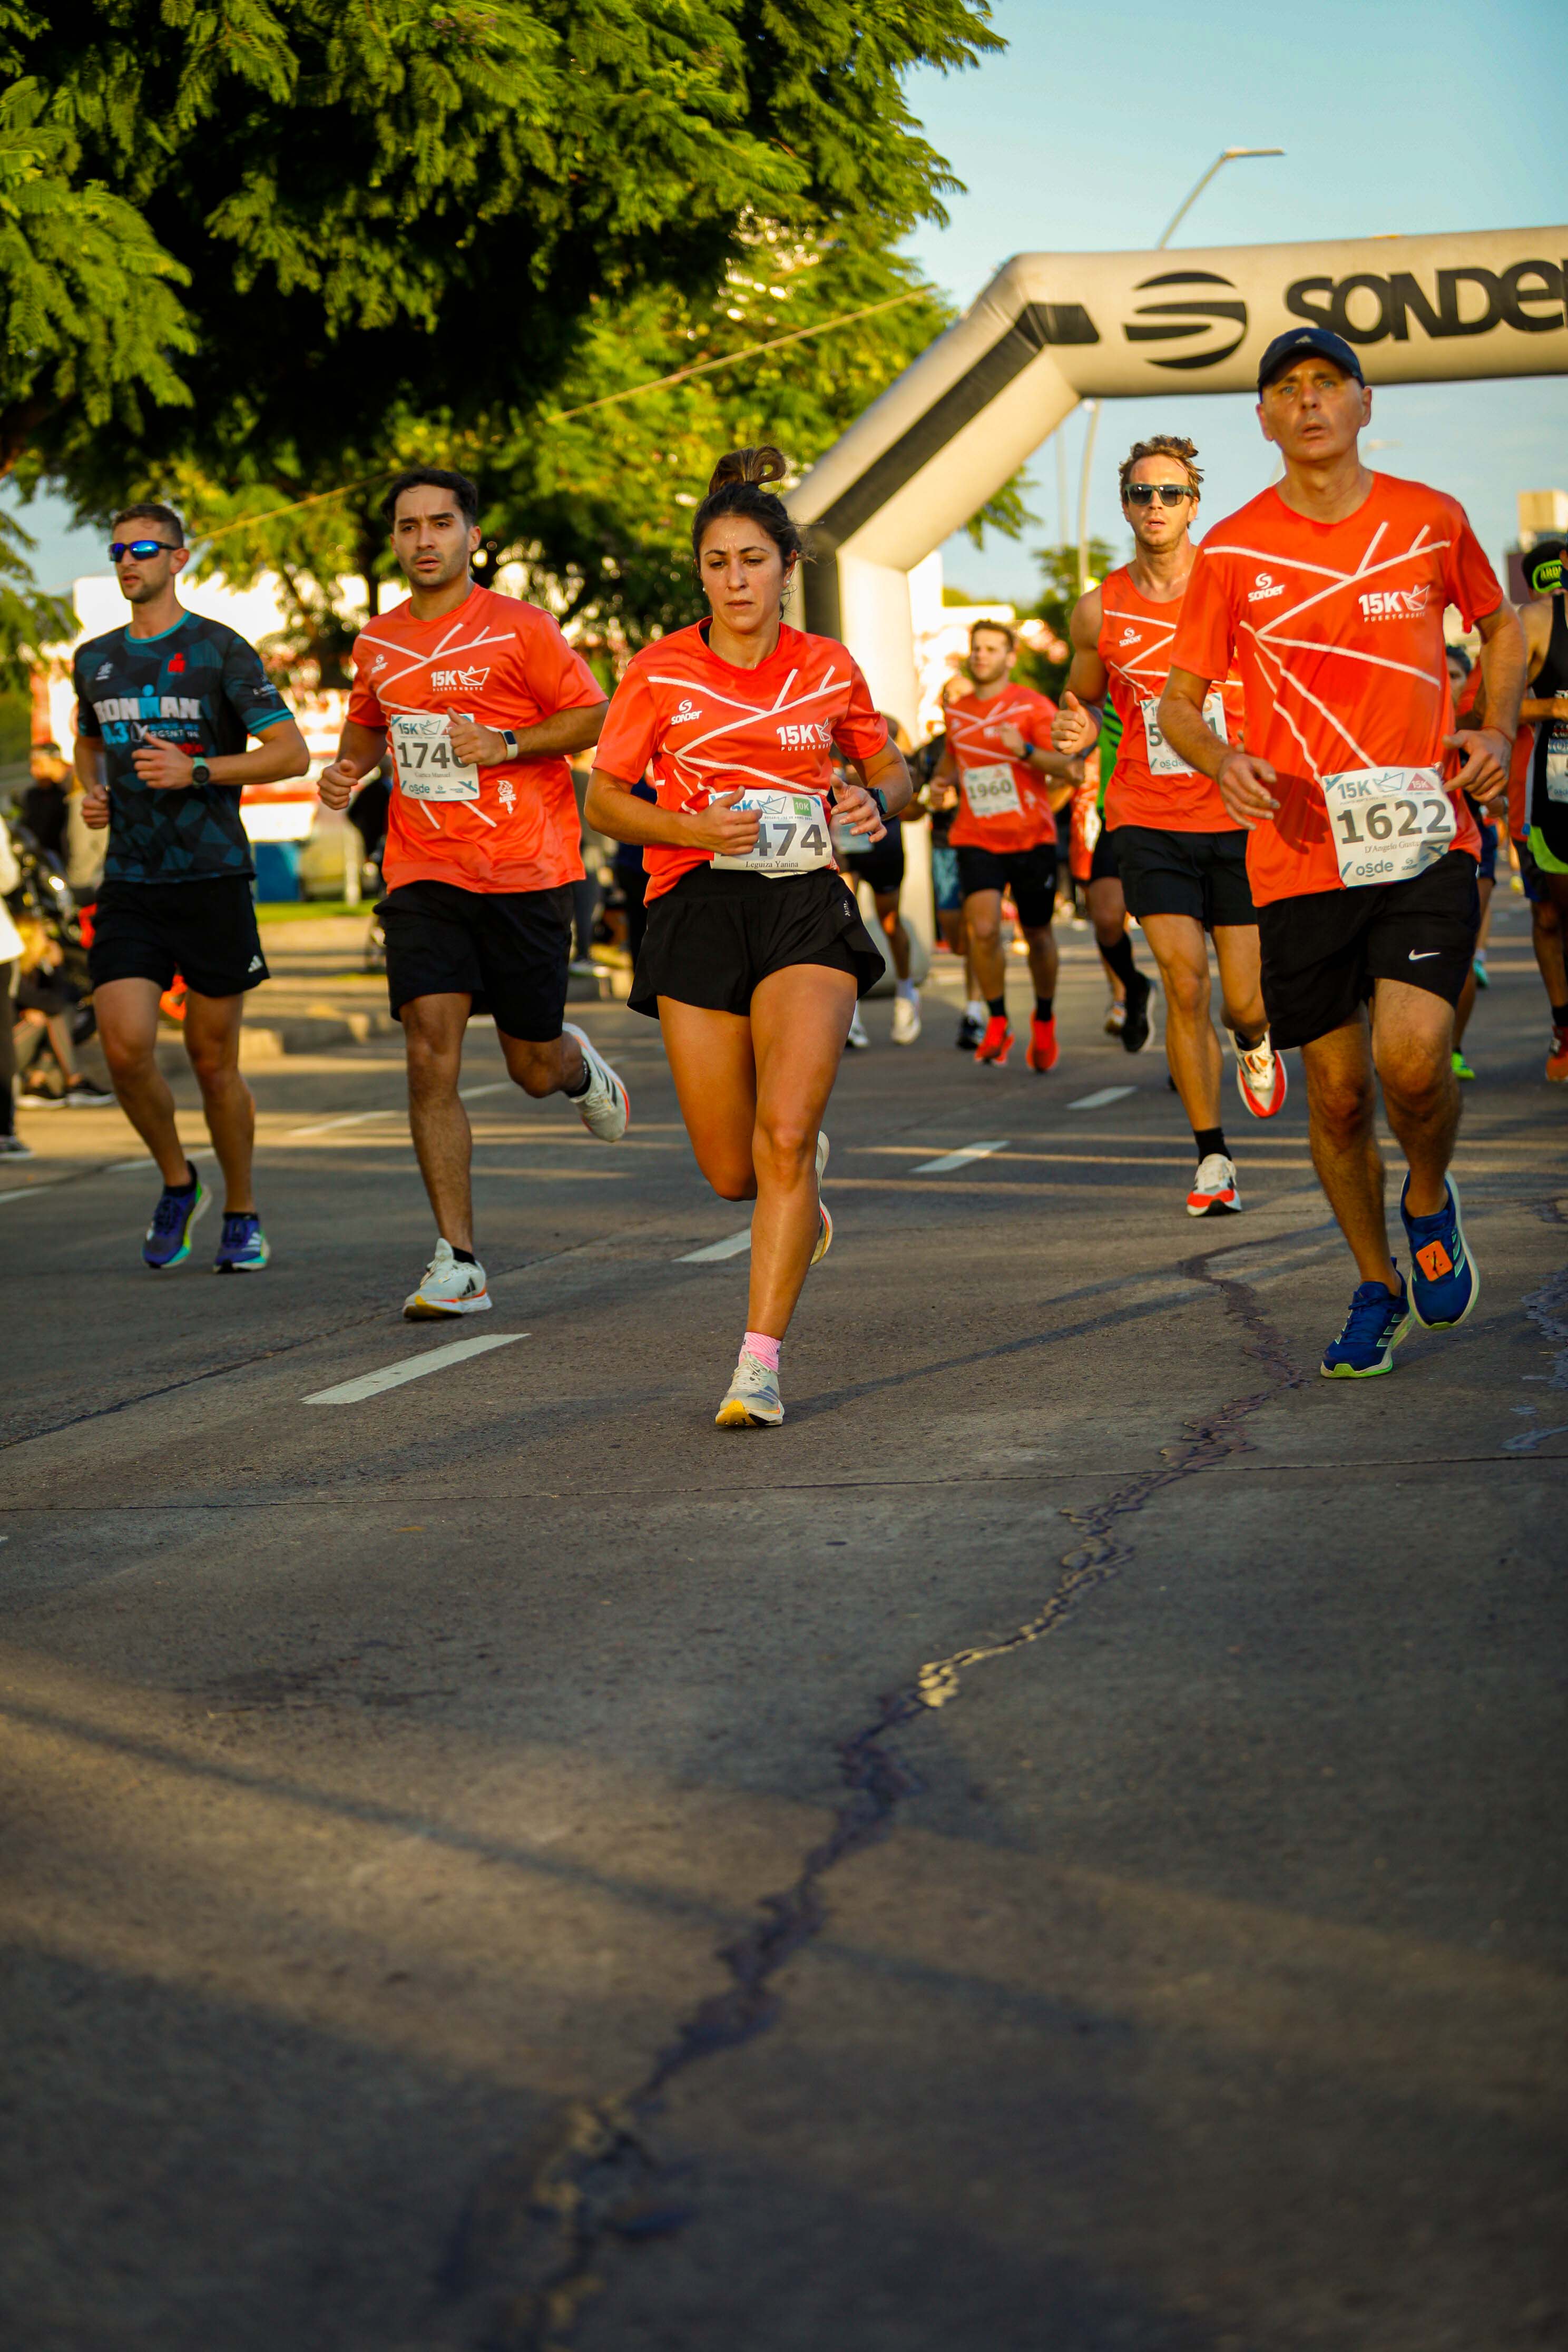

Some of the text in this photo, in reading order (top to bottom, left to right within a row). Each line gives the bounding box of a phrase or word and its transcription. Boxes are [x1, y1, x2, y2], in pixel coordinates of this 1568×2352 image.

[1287, 260, 1568, 344] SONDe
[1358, 592, 1402, 615] 15K
[431, 670, 457, 687] 15K
[398, 723, 418, 735] 15K
[776, 724, 816, 745] 15K
[1148, 717, 1227, 746] 51
[409, 784, 430, 794] osde
[968, 778, 1013, 799] 1960
[1337, 780, 1371, 799] 15K
[795, 802, 809, 810] 10K
[1336, 799, 1451, 844] 1622
[721, 823, 827, 856] 474
[746, 860, 773, 869] Leguiza
[1356, 860, 1394, 877] osde
